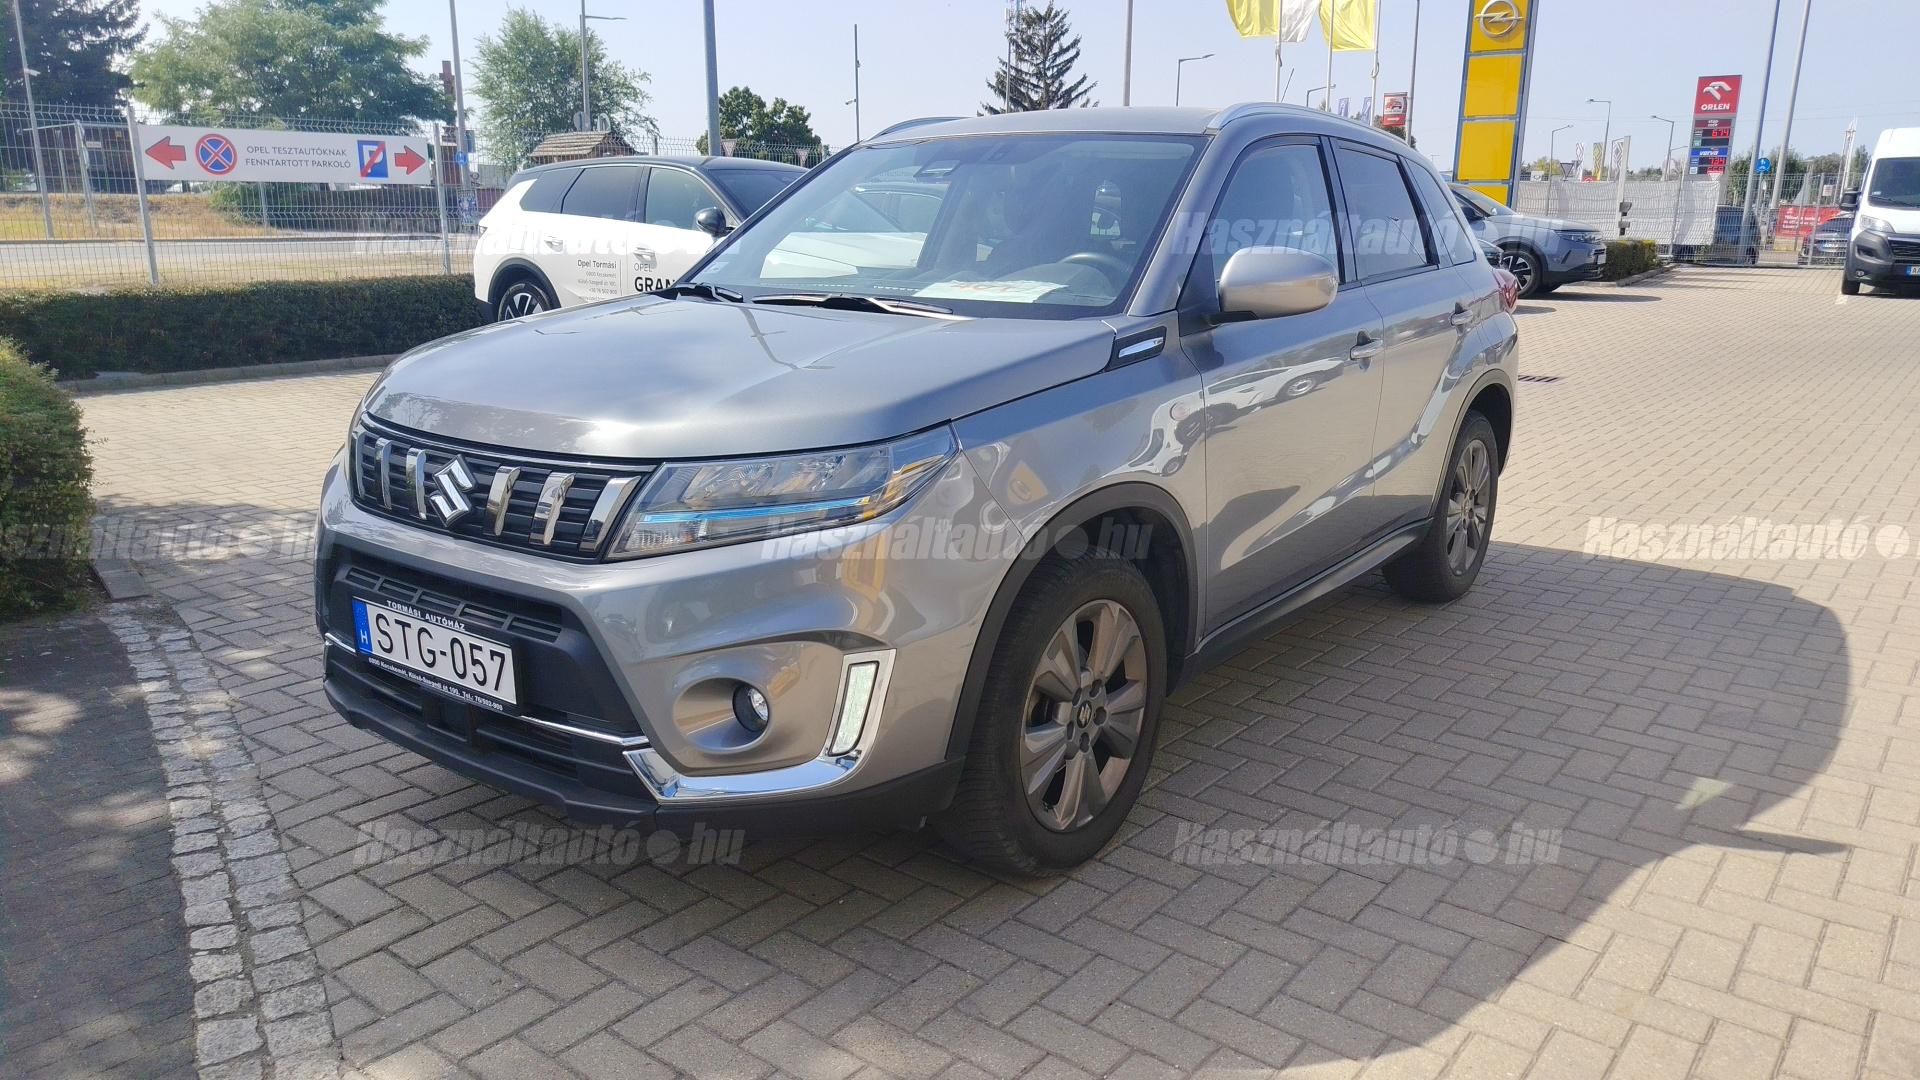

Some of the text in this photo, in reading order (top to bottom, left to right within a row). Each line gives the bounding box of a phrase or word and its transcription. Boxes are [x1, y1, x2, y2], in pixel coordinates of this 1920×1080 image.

[1701, 103, 1731, 111] ORLEN
[246, 146, 348, 158] OPEL TESZTAUTÓKNAK
[245, 158, 351, 169] FENNTARTOTT PARKOLÓ
[578, 260, 617, 269] Opel Tormási
[634, 263, 653, 272] OPEL
[387, 600, 466, 631] TORMÁSI AUTÓHÁZ
[360, 630, 368, 645] H
[375, 612, 506, 692] STG-057
